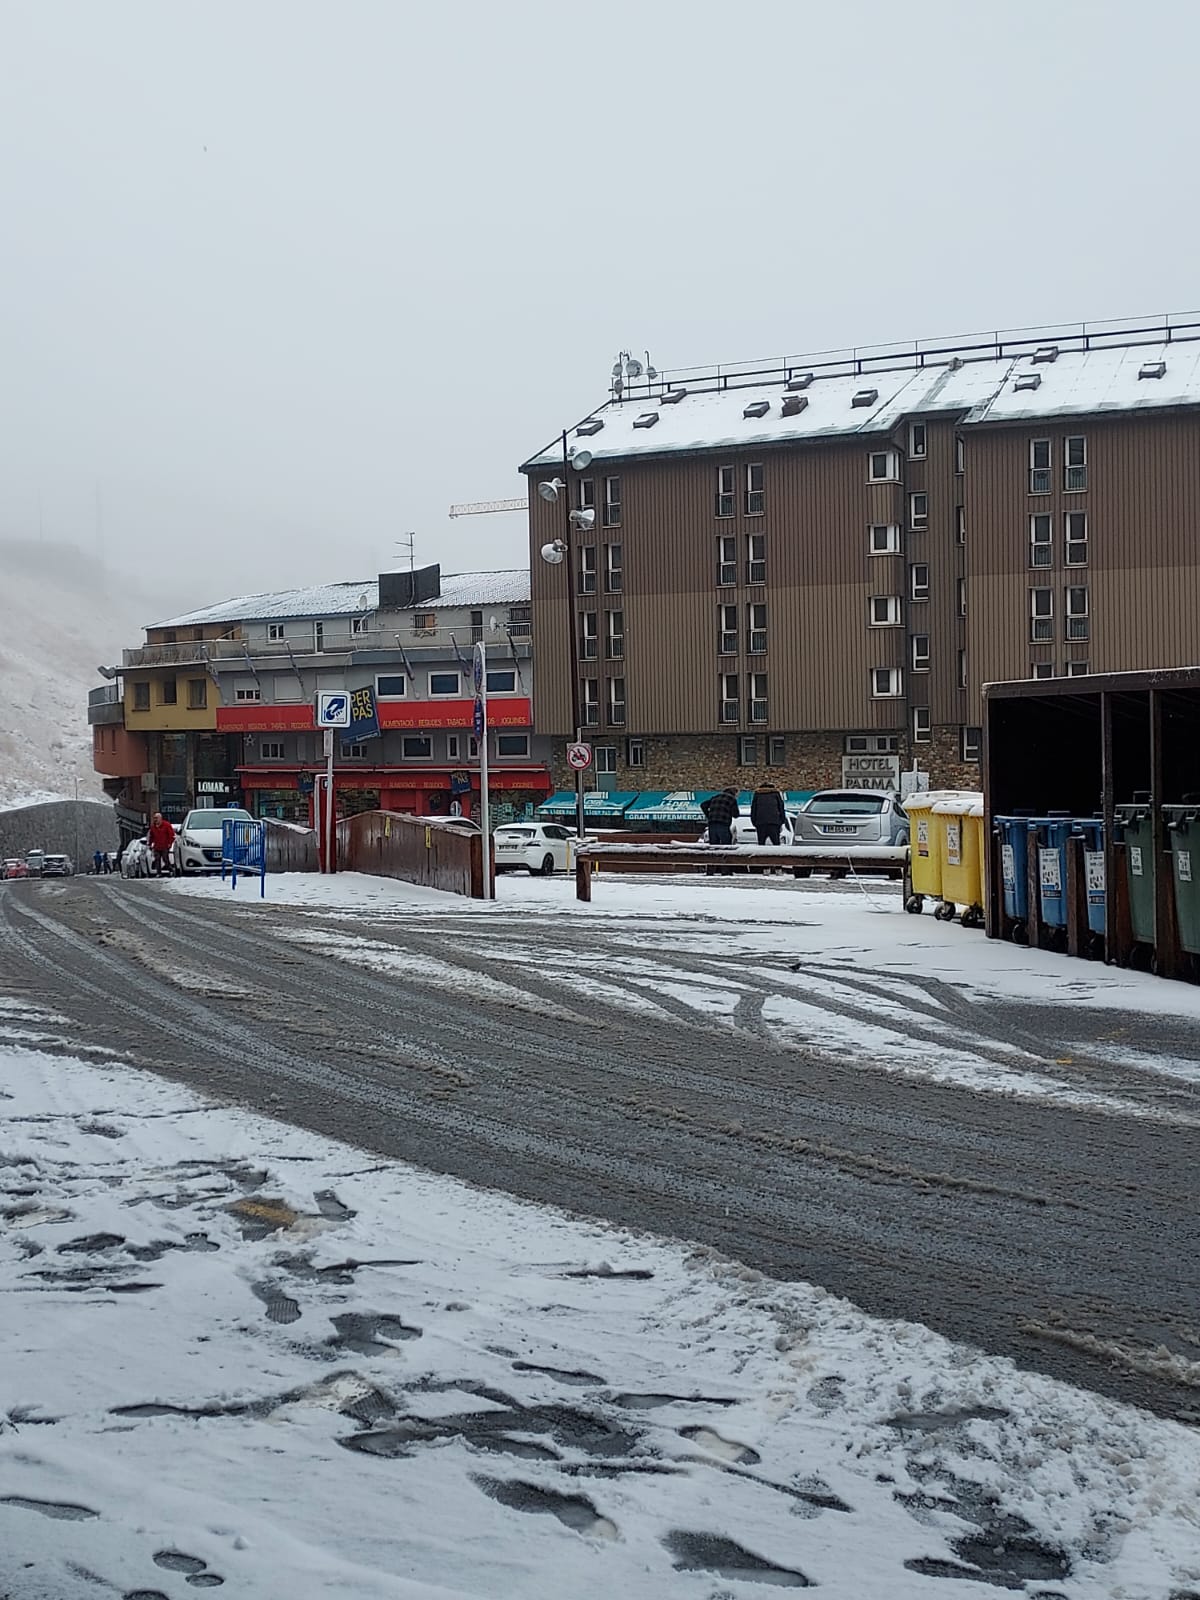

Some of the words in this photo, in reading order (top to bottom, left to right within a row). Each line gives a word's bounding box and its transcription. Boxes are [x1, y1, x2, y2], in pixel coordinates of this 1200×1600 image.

[352, 703, 374, 722] PAS
[849, 758, 893, 771] HOTEL
[198, 781, 225, 793] LOMAR
[845, 779, 896, 790] PARMA
